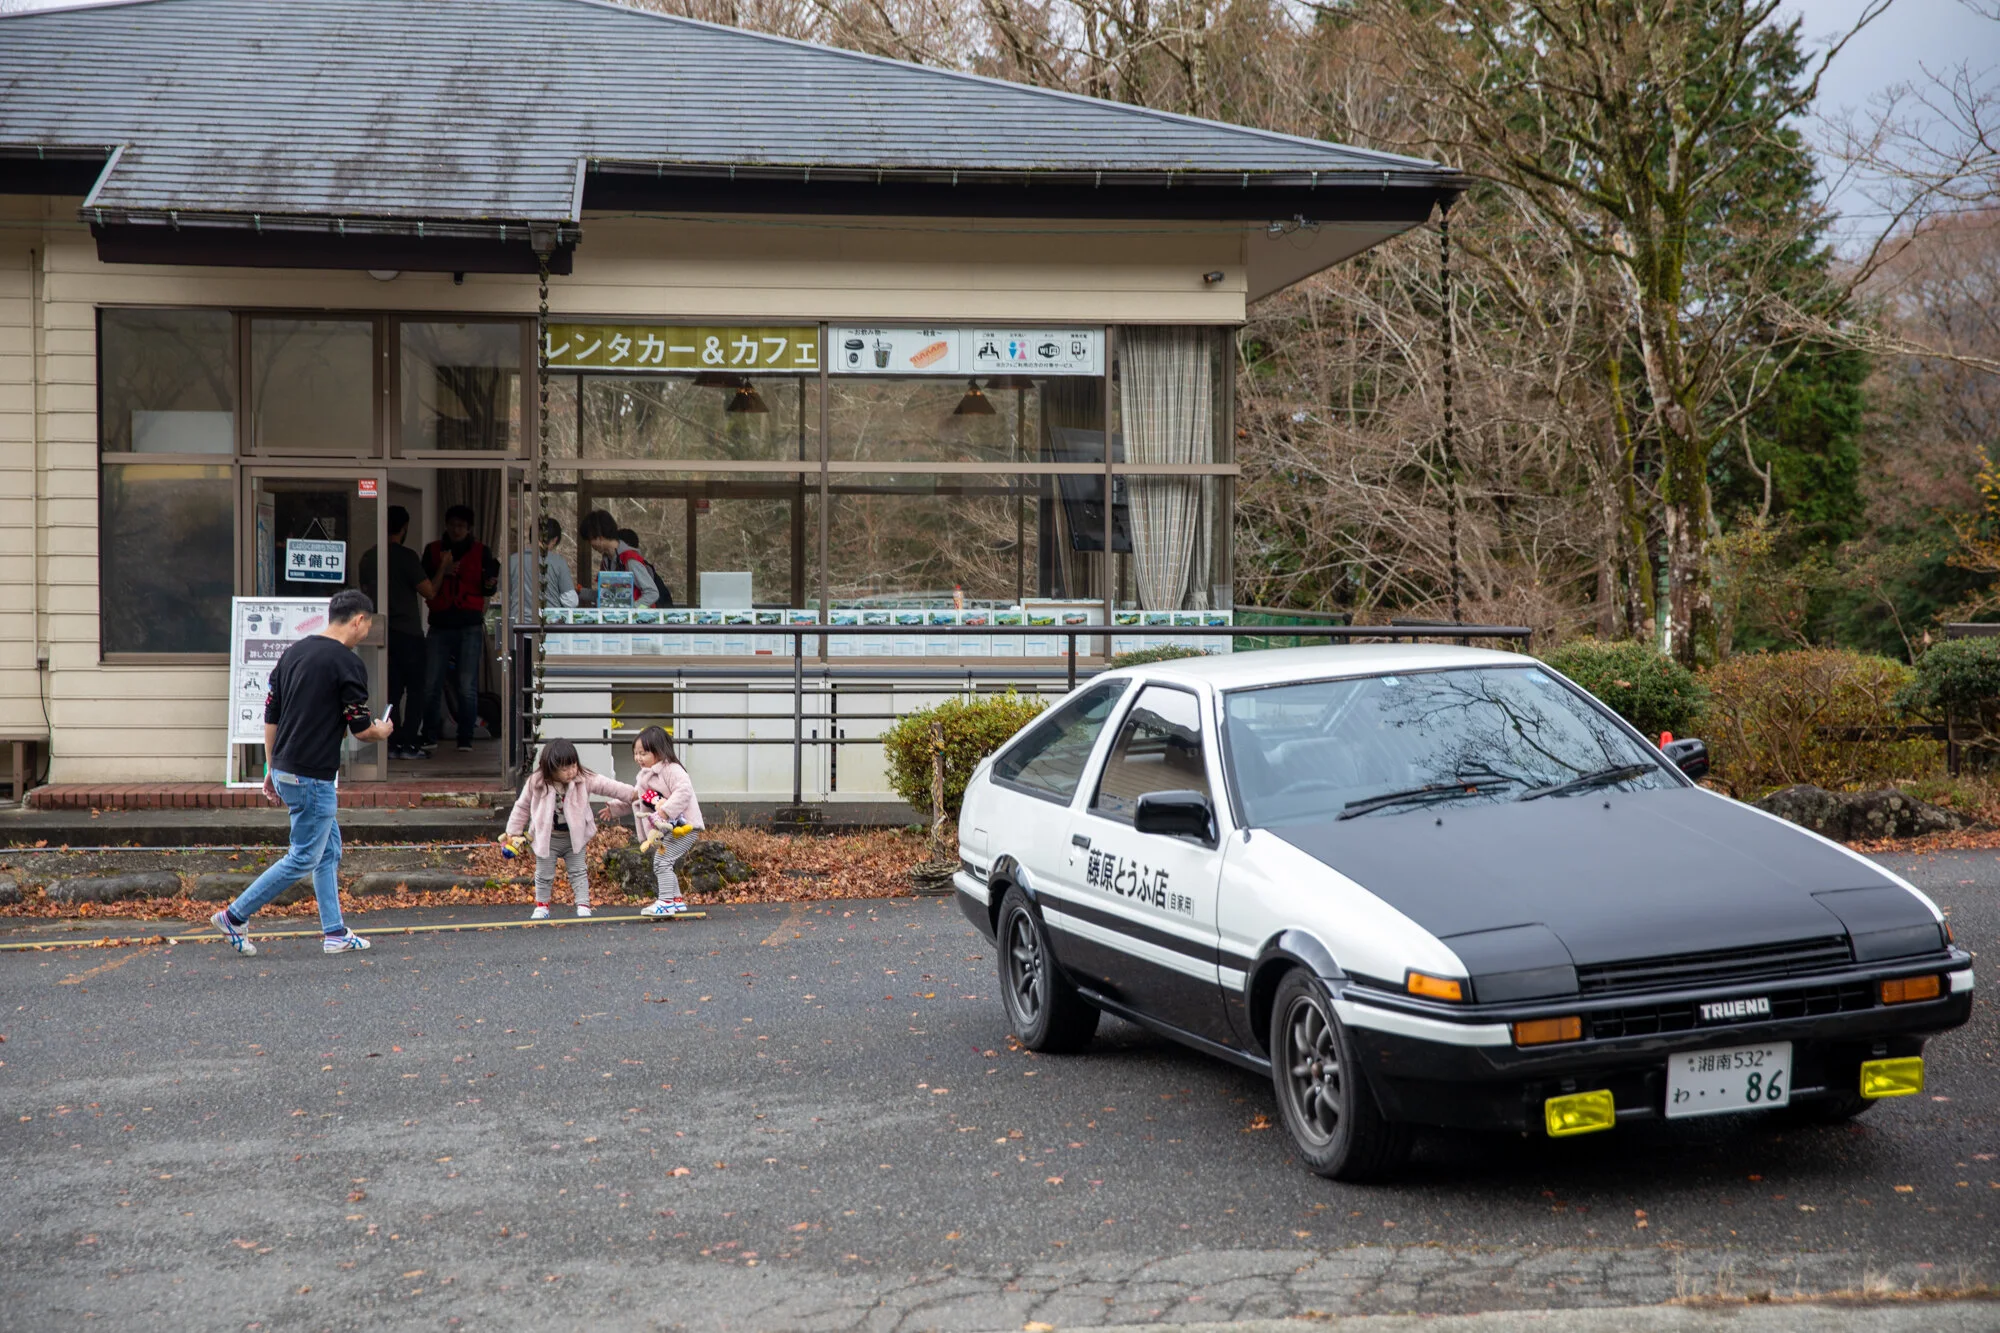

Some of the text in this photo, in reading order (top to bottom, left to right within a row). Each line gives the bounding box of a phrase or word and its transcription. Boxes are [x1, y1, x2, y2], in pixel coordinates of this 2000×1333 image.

[545, 332, 817, 365] レンタカー&カフェ
[292, 552, 340, 569] 準備中
[1700, 997, 1770, 1019] TRUENO
